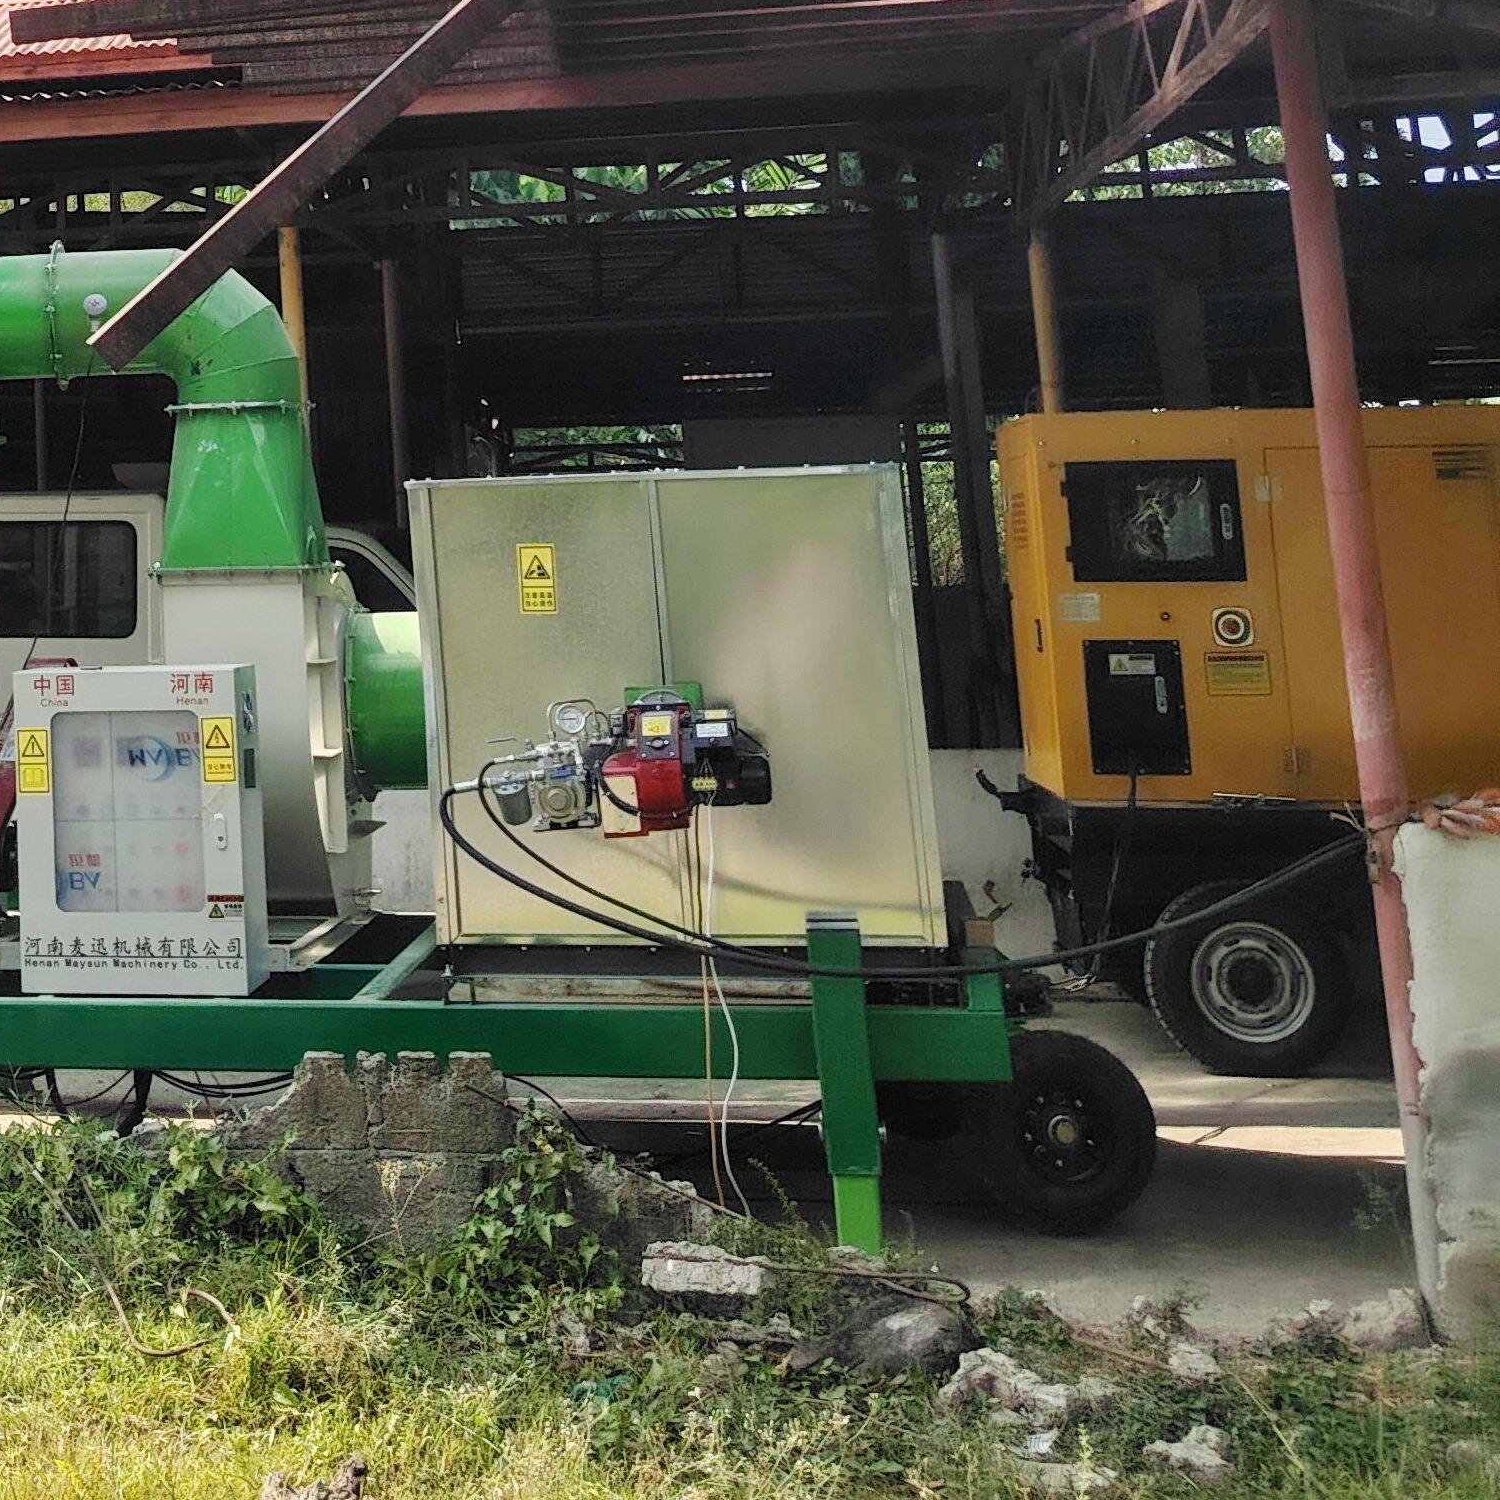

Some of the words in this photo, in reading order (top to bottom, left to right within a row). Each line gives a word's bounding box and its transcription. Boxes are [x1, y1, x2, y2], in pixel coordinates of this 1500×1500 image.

[33, 674, 75, 696] 中国
[170, 671, 214, 694] 河南
[40, 698, 69, 708] China
[176, 696, 210, 706] Henan
[24, 936, 242, 958] 河南麦迅机械有限公司
[24, 958, 60, 968] Henan
[64, 958, 108, 970] Maysun
[112, 958, 178, 971] Machinery
[217, 959, 244, 970] Ltd.
